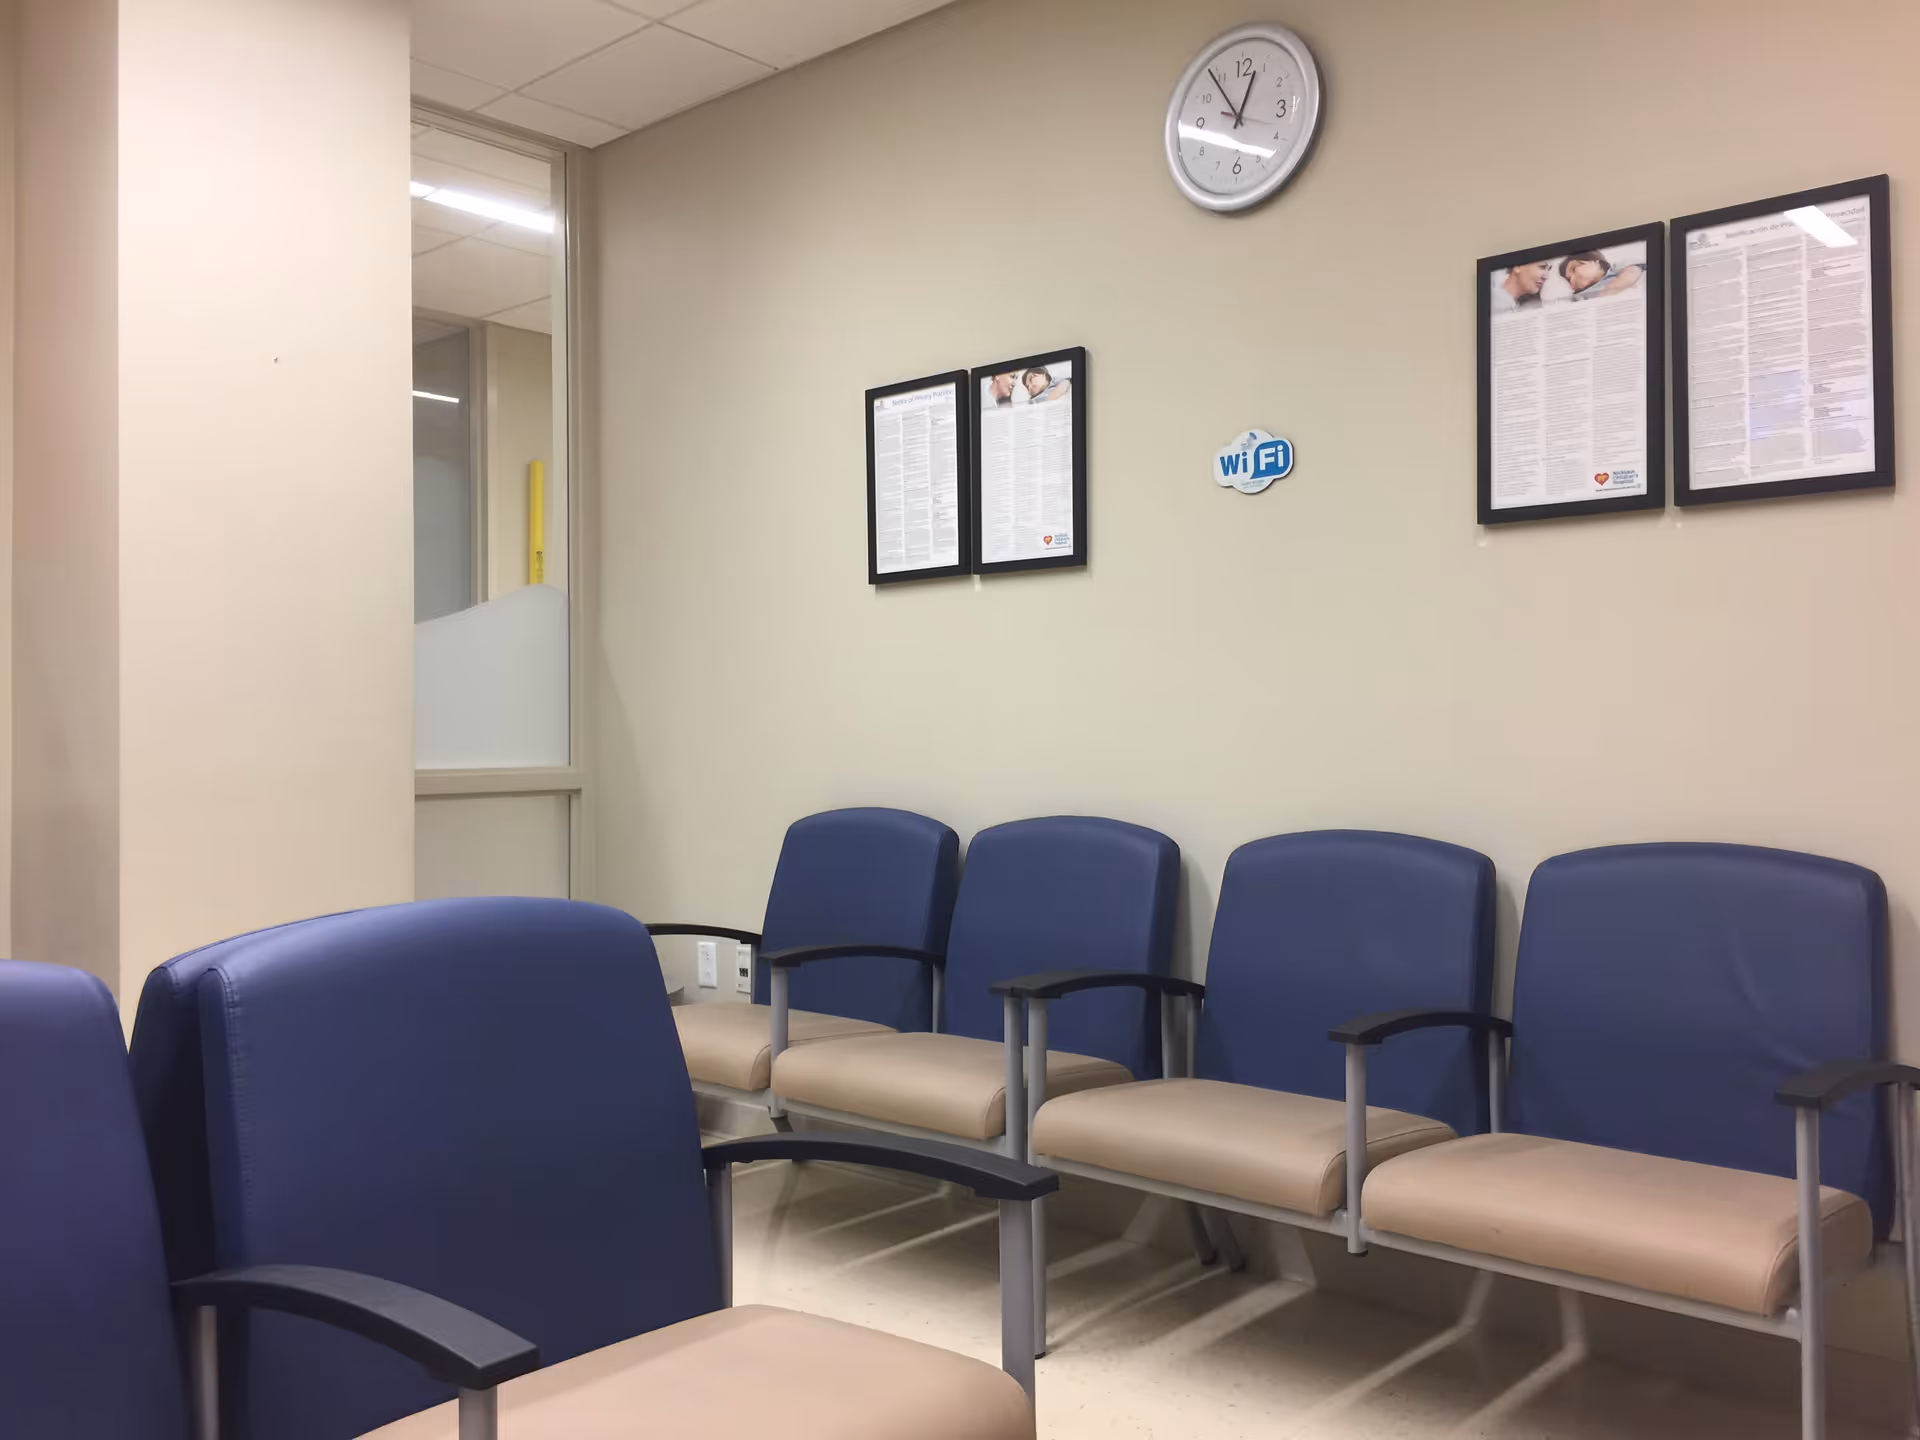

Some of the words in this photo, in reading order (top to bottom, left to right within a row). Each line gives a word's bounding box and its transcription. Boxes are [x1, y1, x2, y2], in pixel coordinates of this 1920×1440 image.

[1235, 57, 1253, 79] 12
[1217, 73, 1227, 83] 11
[1275, 76, 1283, 88] 2
[1202, 93, 1212, 105] 10
[1275, 99, 1287, 118] 3
[1273, 131, 1279, 140] 4
[1198, 146, 1205, 157] 8
[1215, 160, 1221, 171] 7
[1231, 156, 1242, 175] 6
